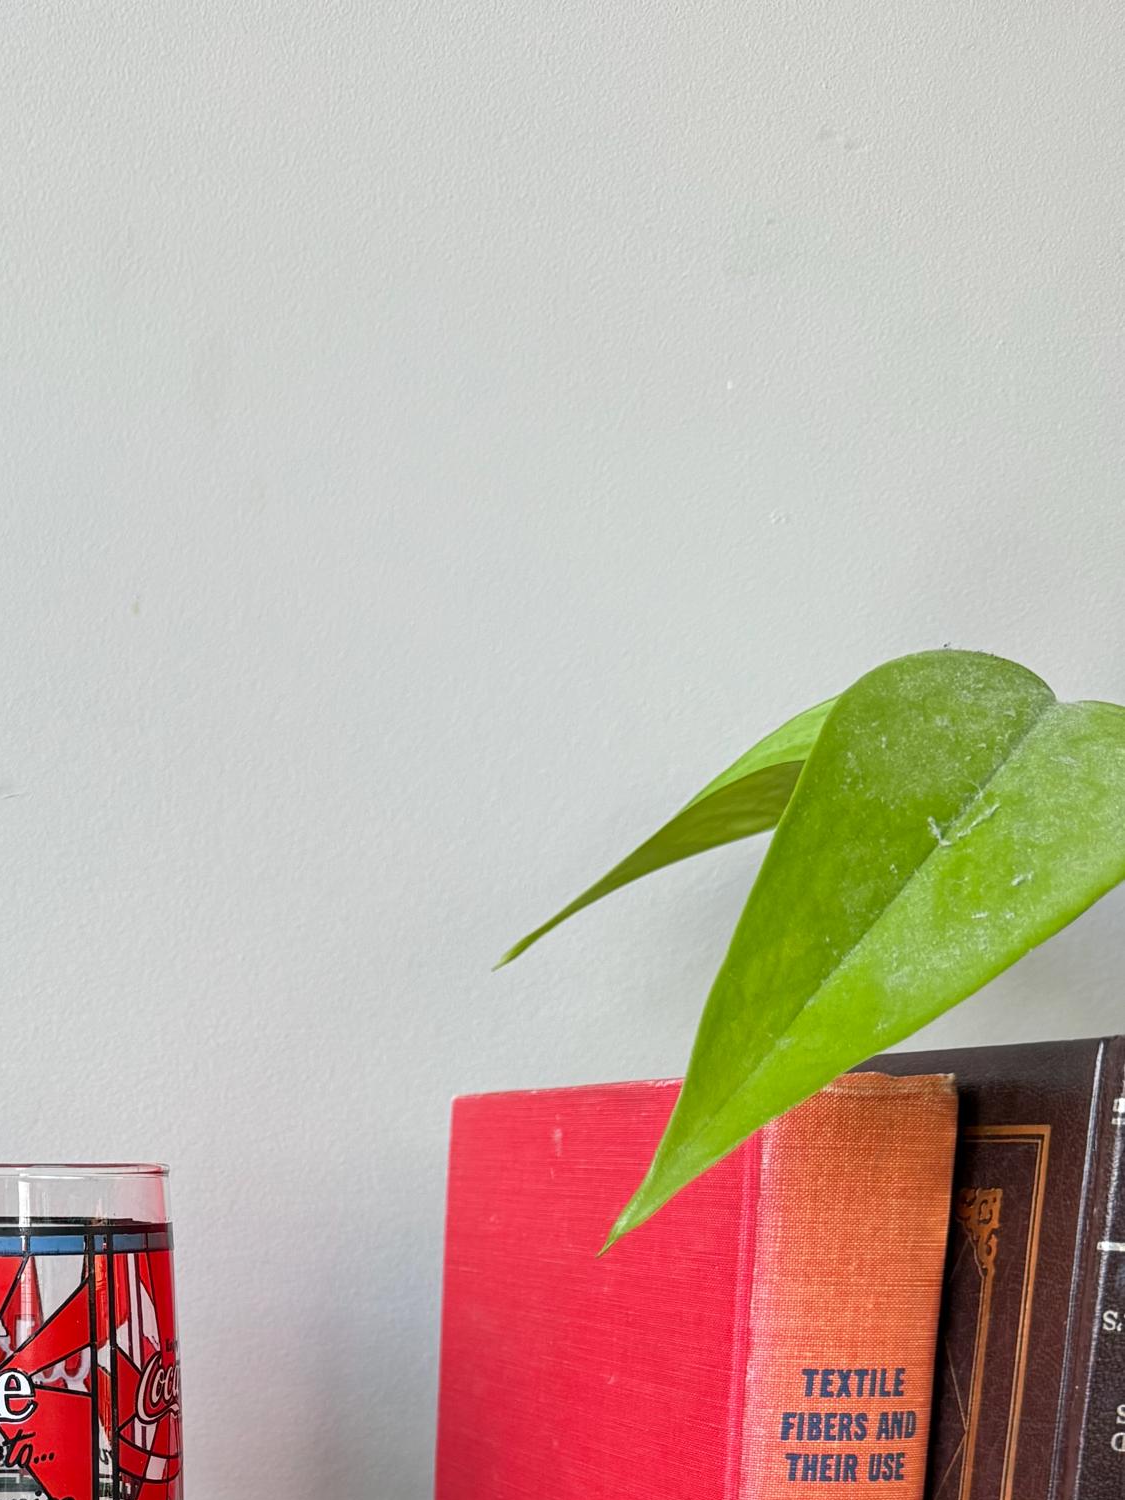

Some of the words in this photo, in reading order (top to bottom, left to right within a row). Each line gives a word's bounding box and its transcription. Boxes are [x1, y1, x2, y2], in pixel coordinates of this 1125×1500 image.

[802, 1368, 906, 1398] TEXTILE
[780, 1411, 868, 1441] FIBERS
[876, 1411, 917, 1440] AND
[785, 1453, 859, 1482] THEIR
[868, 1452, 906, 1481] USE
